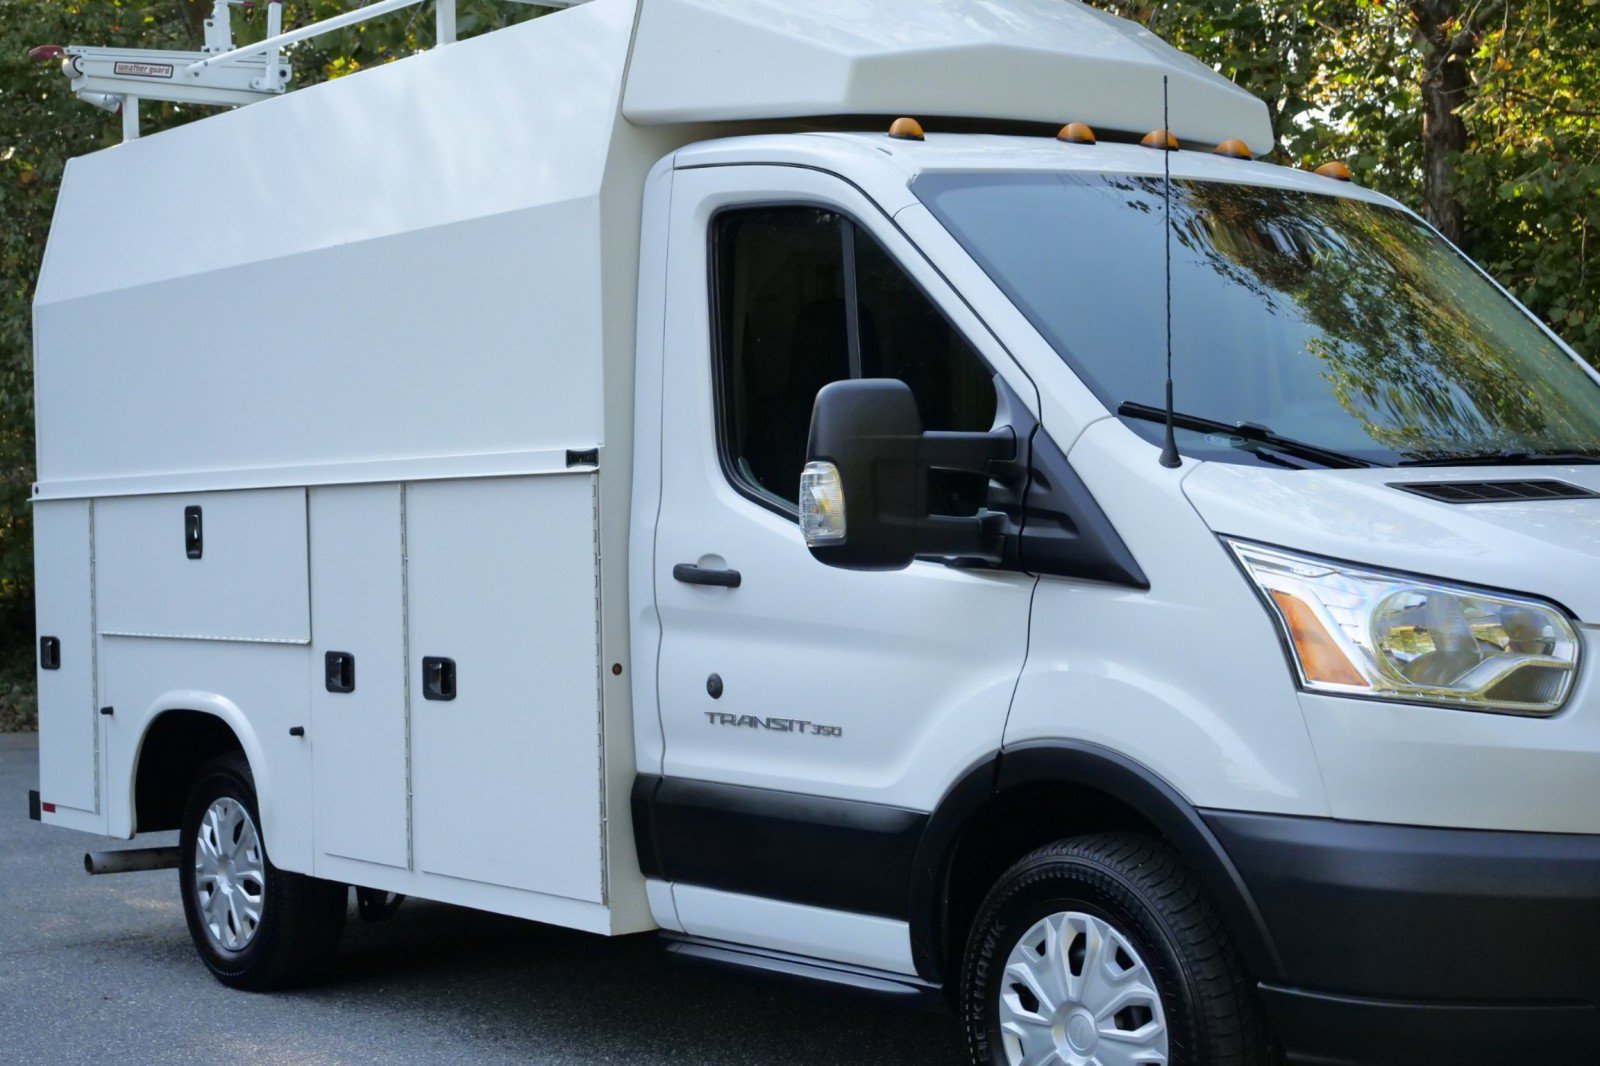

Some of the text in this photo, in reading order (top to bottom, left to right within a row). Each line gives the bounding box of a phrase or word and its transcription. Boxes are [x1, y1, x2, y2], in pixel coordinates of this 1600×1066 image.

[117, 64, 170, 75] weather guard
[703, 711, 843, 737] TRANSIT 350
